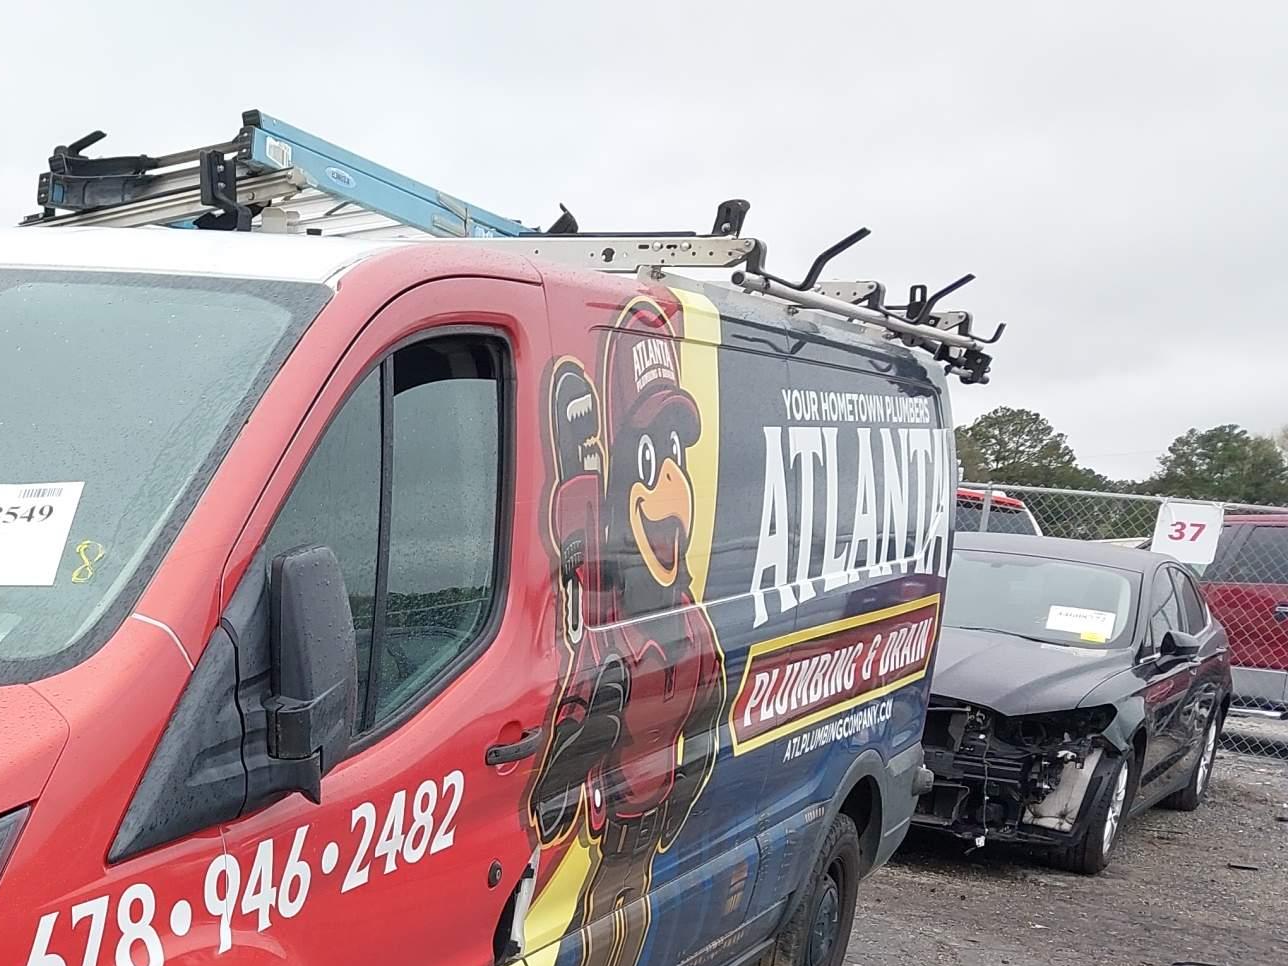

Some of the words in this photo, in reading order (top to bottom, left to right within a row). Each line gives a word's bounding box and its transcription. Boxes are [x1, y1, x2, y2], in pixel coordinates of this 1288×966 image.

[632, 339, 674, 382] ATLANTA
[782, 388, 821, 421] YOUR
[821, 392, 885, 423] HOMETOWN
[885, 397, 930, 424] PLUMBERS
[749, 425, 951, 629] ATLANTA
[1167, 521, 1207, 542] 37
[71, 539, 105, 584] 8
[743, 642, 864, 727] PLUMBING
[862, 633, 882, 681] &
[878, 616, 933, 676] DRAIN
